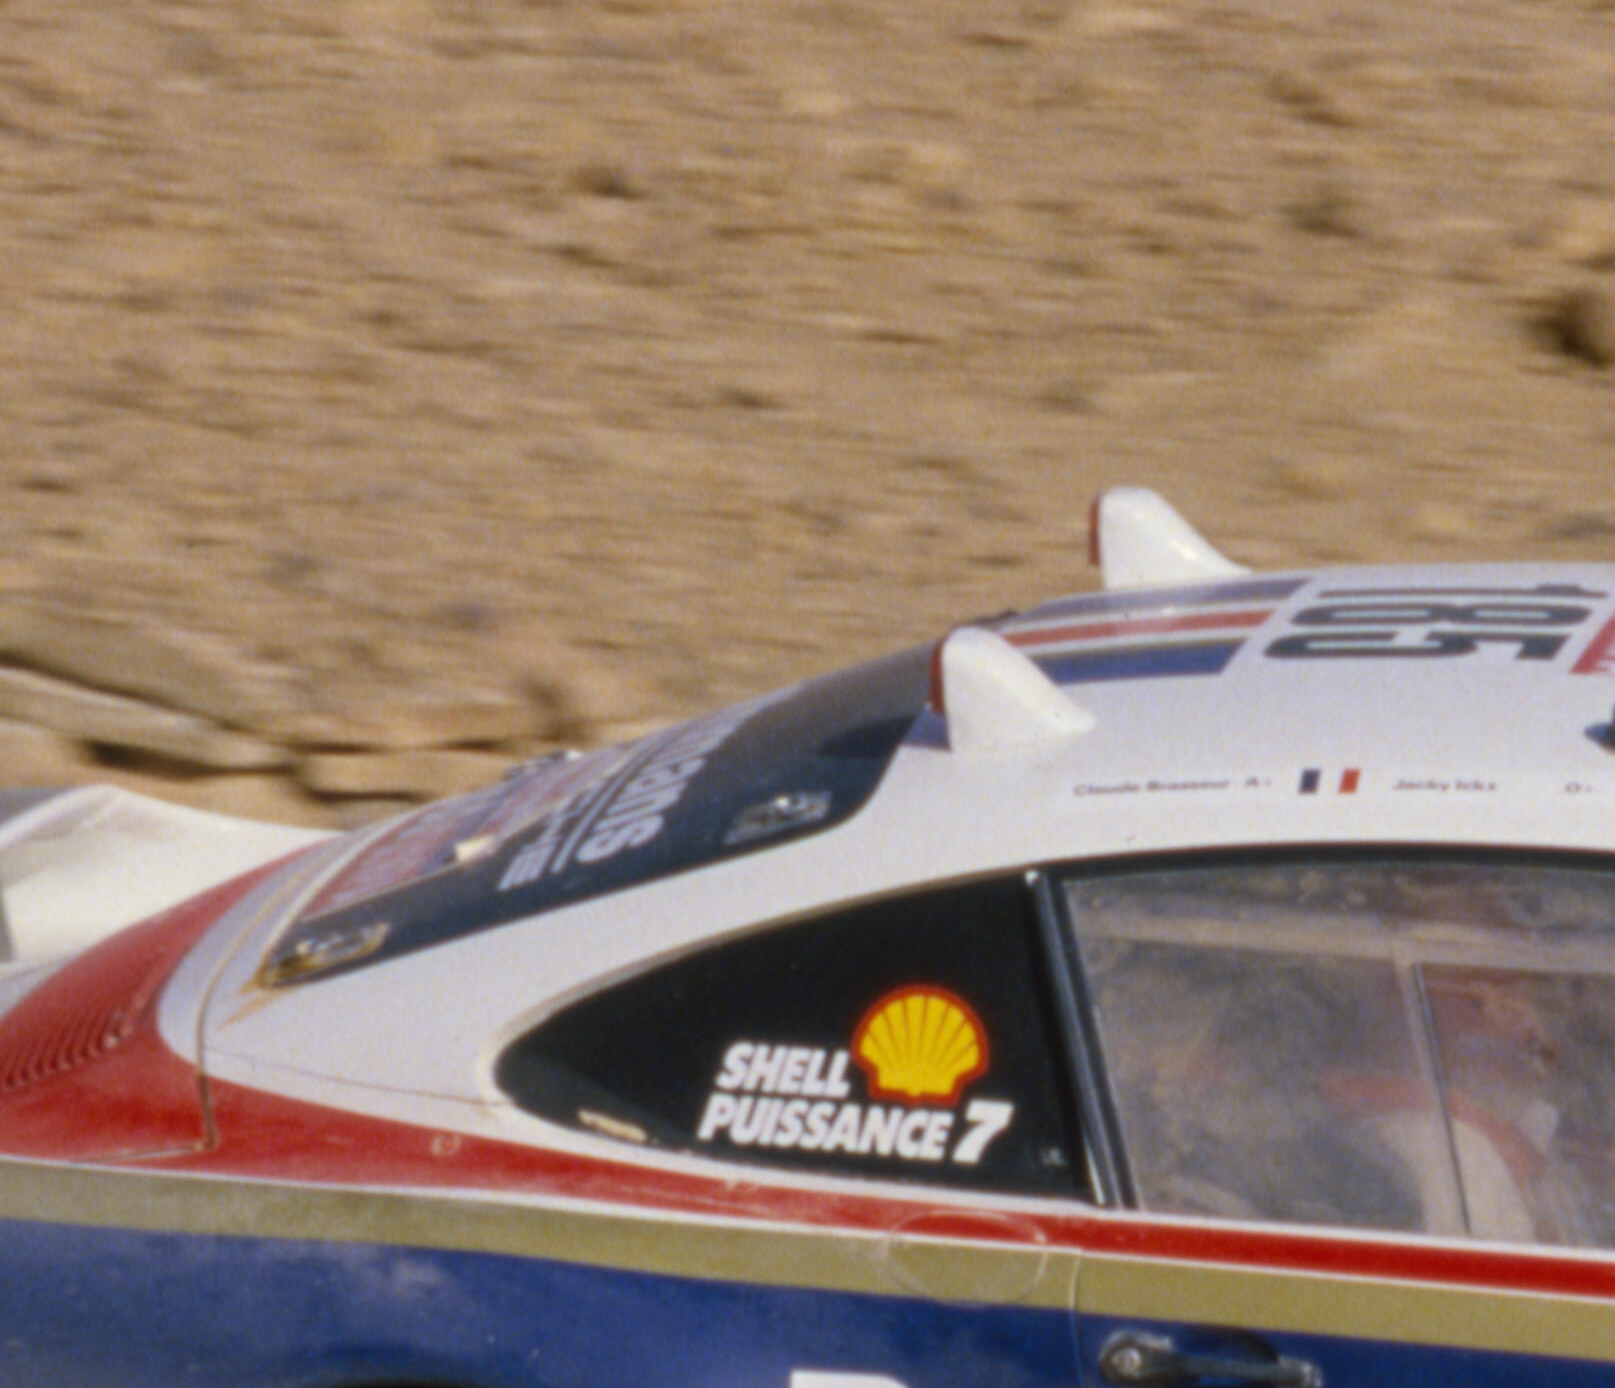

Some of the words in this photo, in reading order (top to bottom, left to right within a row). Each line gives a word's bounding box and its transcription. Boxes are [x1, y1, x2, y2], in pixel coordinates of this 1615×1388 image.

[1264, 583, 1610, 661] 185
[715, 1041, 851, 1099] SHELL
[697, 1095, 954, 1160] PUISSANCE
[952, 1099, 1014, 1164] 7
